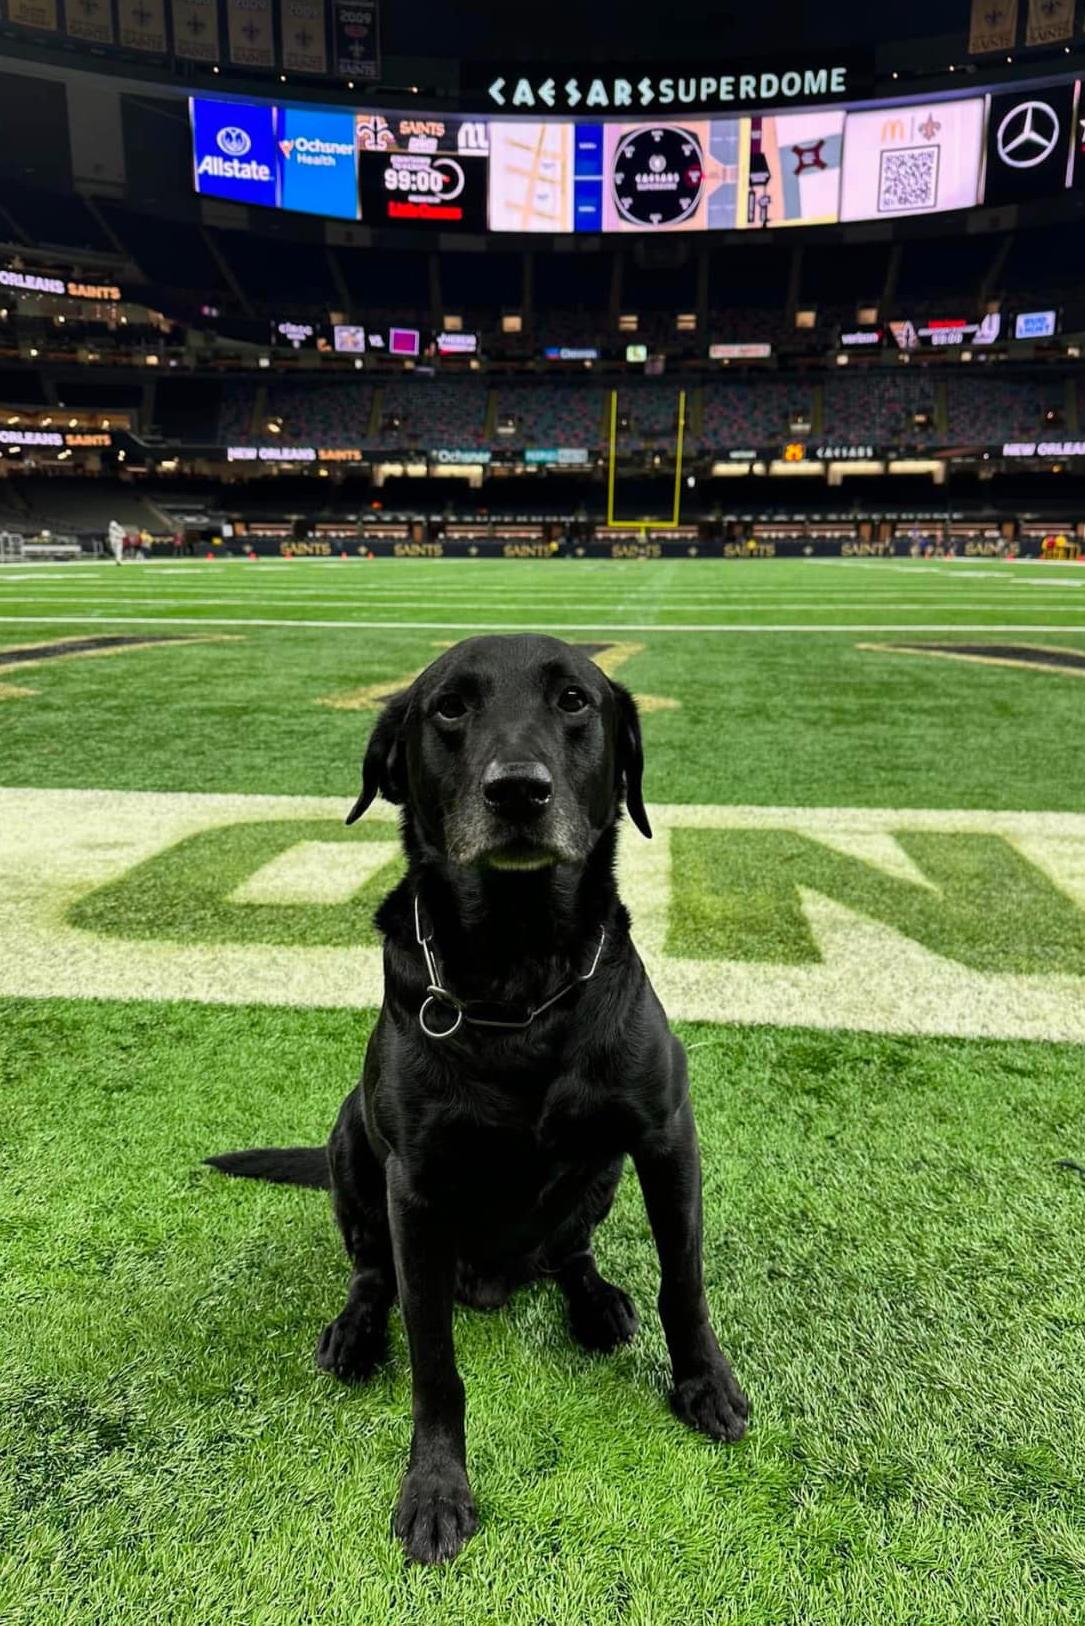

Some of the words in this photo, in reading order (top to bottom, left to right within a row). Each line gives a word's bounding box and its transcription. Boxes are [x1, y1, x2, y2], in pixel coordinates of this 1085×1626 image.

[339, 10, 371, 25] 2009
[488, 77, 655, 107] CAESARS
[658, 67, 847, 103] SUPERDOME
[400, 120, 445, 137] SAINTS
[296, 137, 354, 156] Ochsner
[198, 155, 272, 181] Allstate
[297, 153, 336, 167] Health
[384, 168, 443, 192] 99:00
[0, 270, 65, 294] ORLEANS
[67, 282, 121, 300] SAINTS
[0, 430, 63, 446] ORLEANS
[65, 434, 111, 446] SAINTS
[227, 447, 257, 460] NEW
[258, 447, 317, 461] ORLEANS
[318, 448, 362, 462] SAINTS
[816, 447, 873, 458] CAESARS
[279, 542, 332, 556] SAINTS
[394, 542, 443, 556] SAINTS
